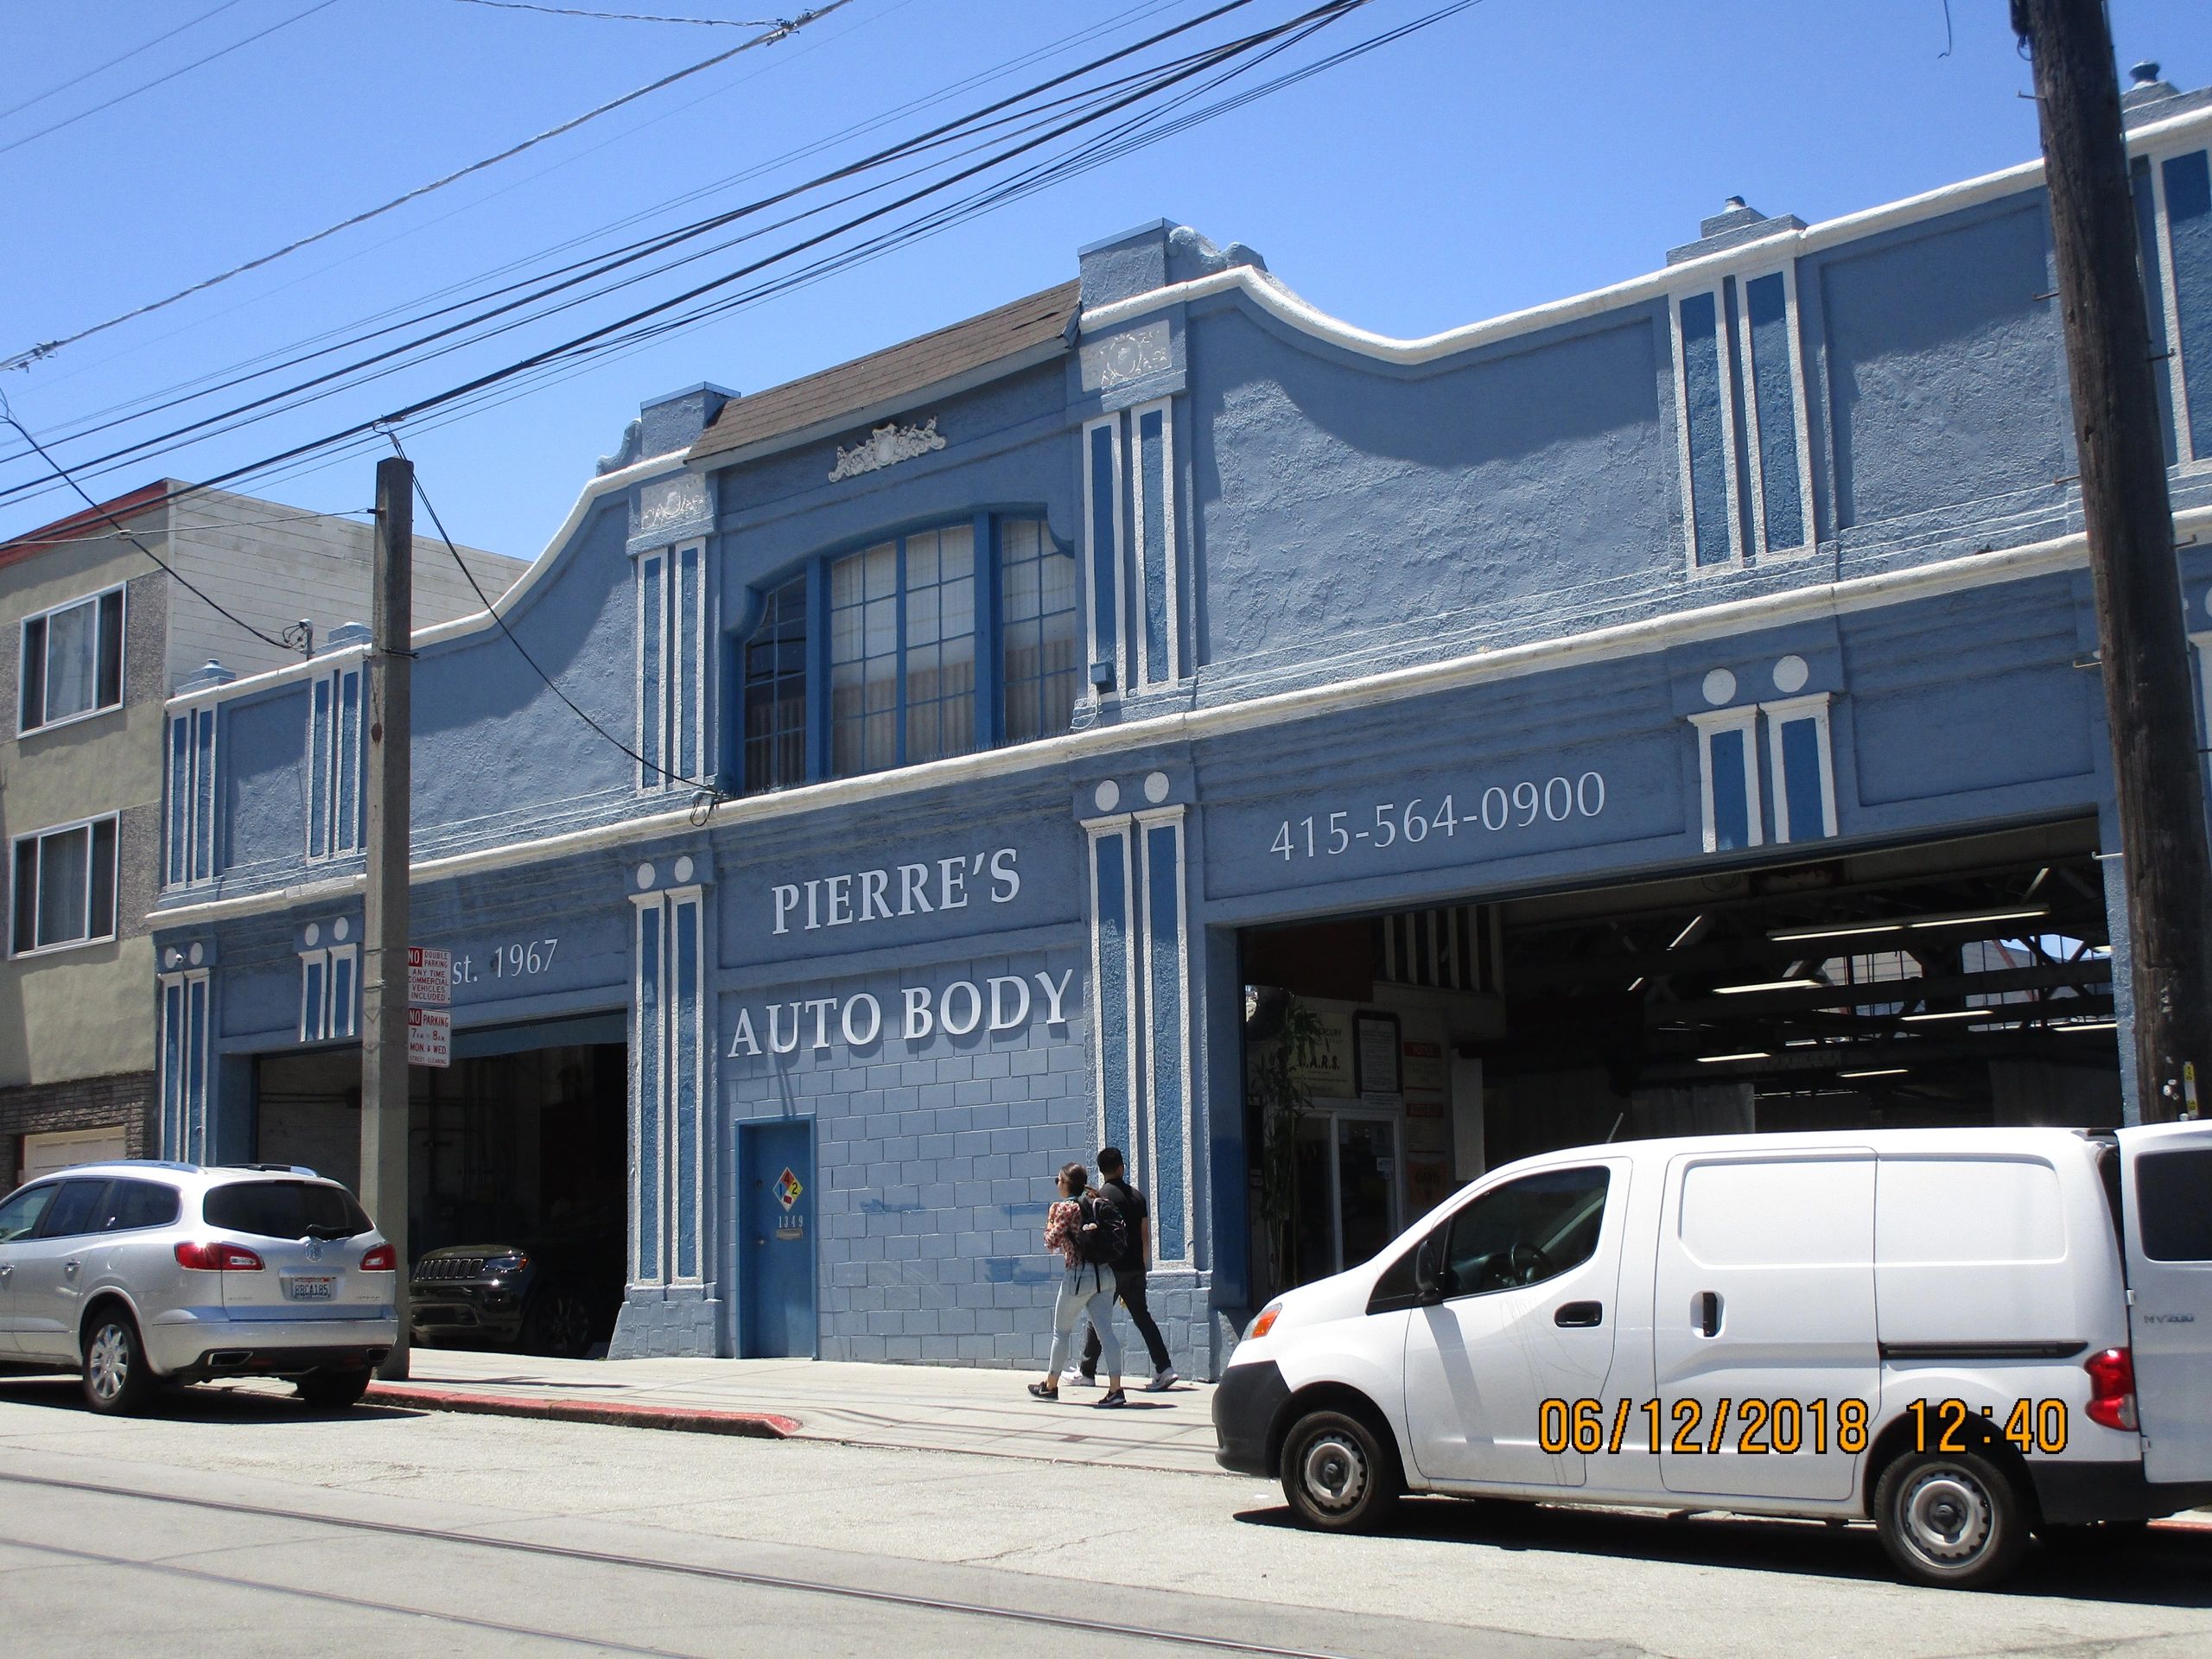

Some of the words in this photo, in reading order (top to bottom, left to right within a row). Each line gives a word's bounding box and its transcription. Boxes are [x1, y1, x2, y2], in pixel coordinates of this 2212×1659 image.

[1269, 771, 1605, 861] 415-564-0900
[772, 848, 1021, 935] PIERRE'S
[409, 950, 420, 964] NO
[424, 951, 448, 960] DOUBLE
[451, 954, 478, 985] st.
[494, 938, 559, 978] 1967
[424, 960, 448, 969] PARKING
[412, 968, 427, 976] ANY
[430, 969, 445, 978] TIME
[408, 976, 448, 986] COMMERCIAL
[412, 984, 446, 994] VEHICLES
[411, 992, 446, 1001] INCLUDED
[409, 1010, 420, 1025] NO
[423, 1014, 449, 1028] PARKING
[727, 993, 882, 1058] AUTO
[900, 969, 1074, 1040] BODY
[784, 1173, 790, 1186] 4
[791, 1181, 798, 1195] 2
[779, 1215, 804, 1229] 1349
